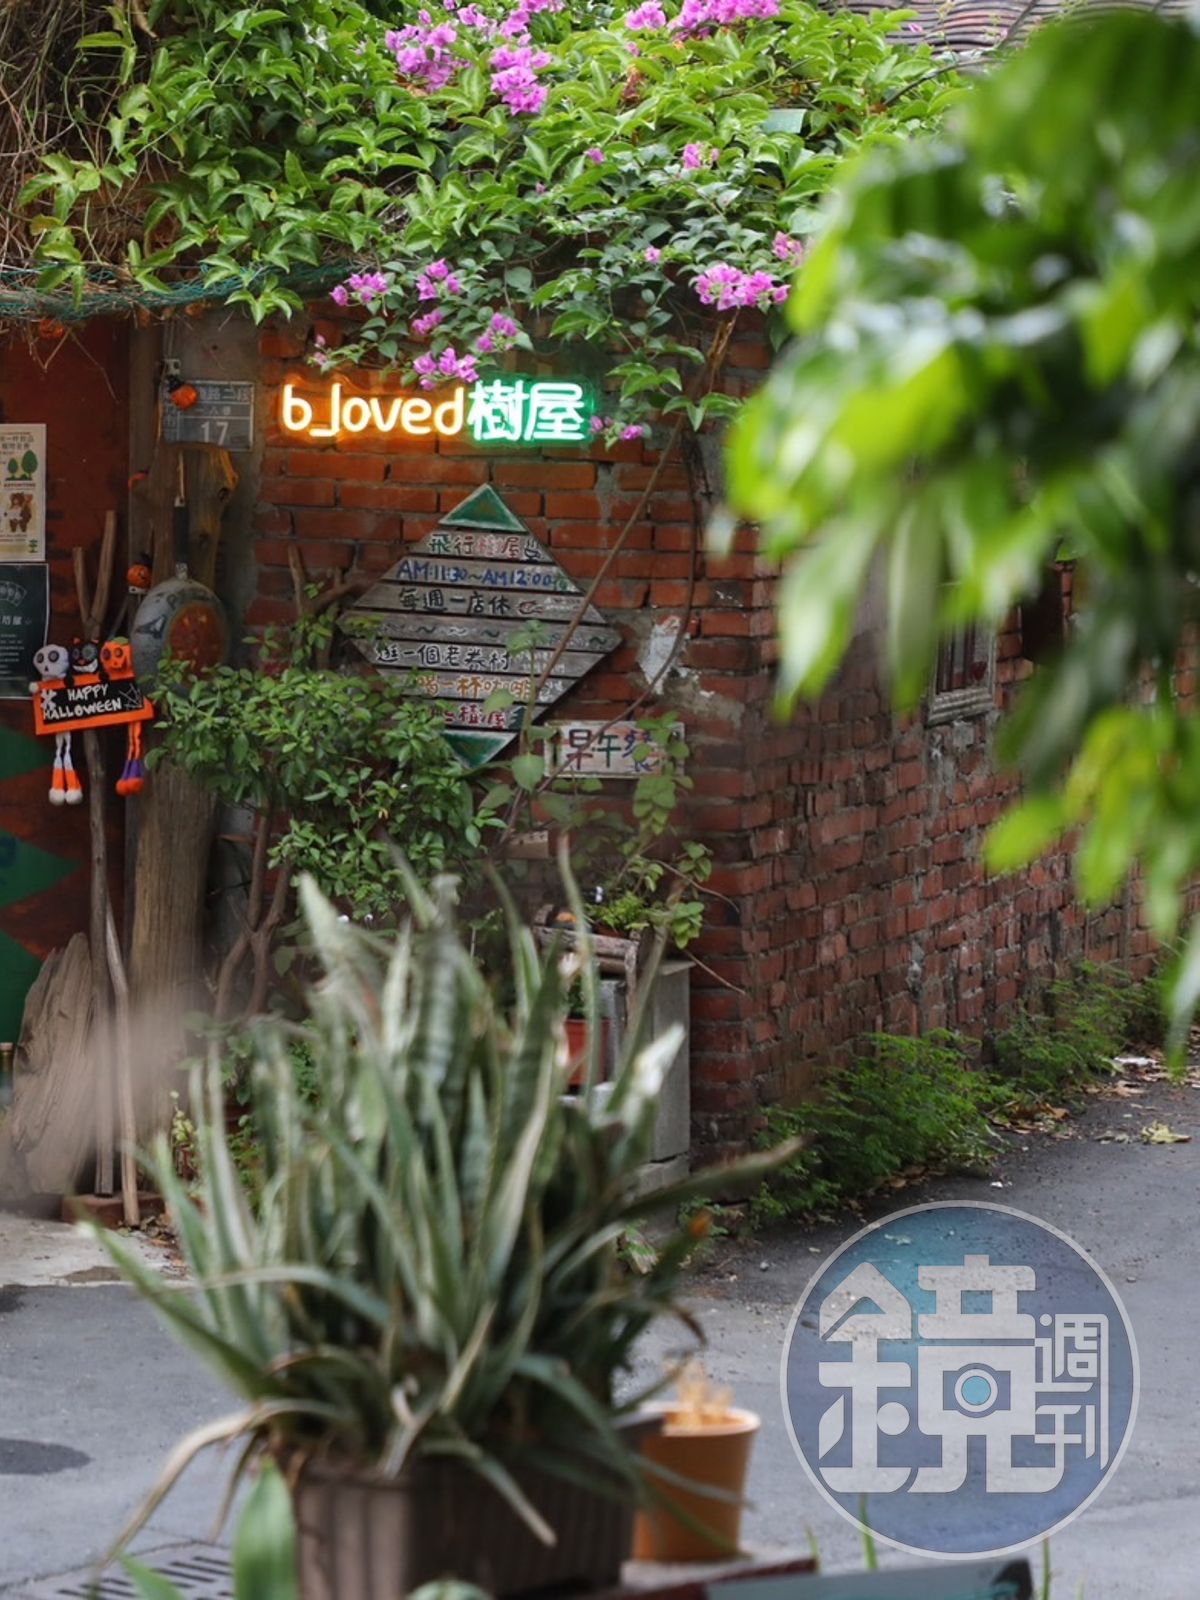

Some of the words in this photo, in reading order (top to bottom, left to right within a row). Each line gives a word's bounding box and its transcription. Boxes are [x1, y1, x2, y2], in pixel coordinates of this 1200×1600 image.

[201, 421, 229, 445] 17
[67, 684, 109, 701] HAPPY
[43, 698, 123, 721] HALLOWEEN
